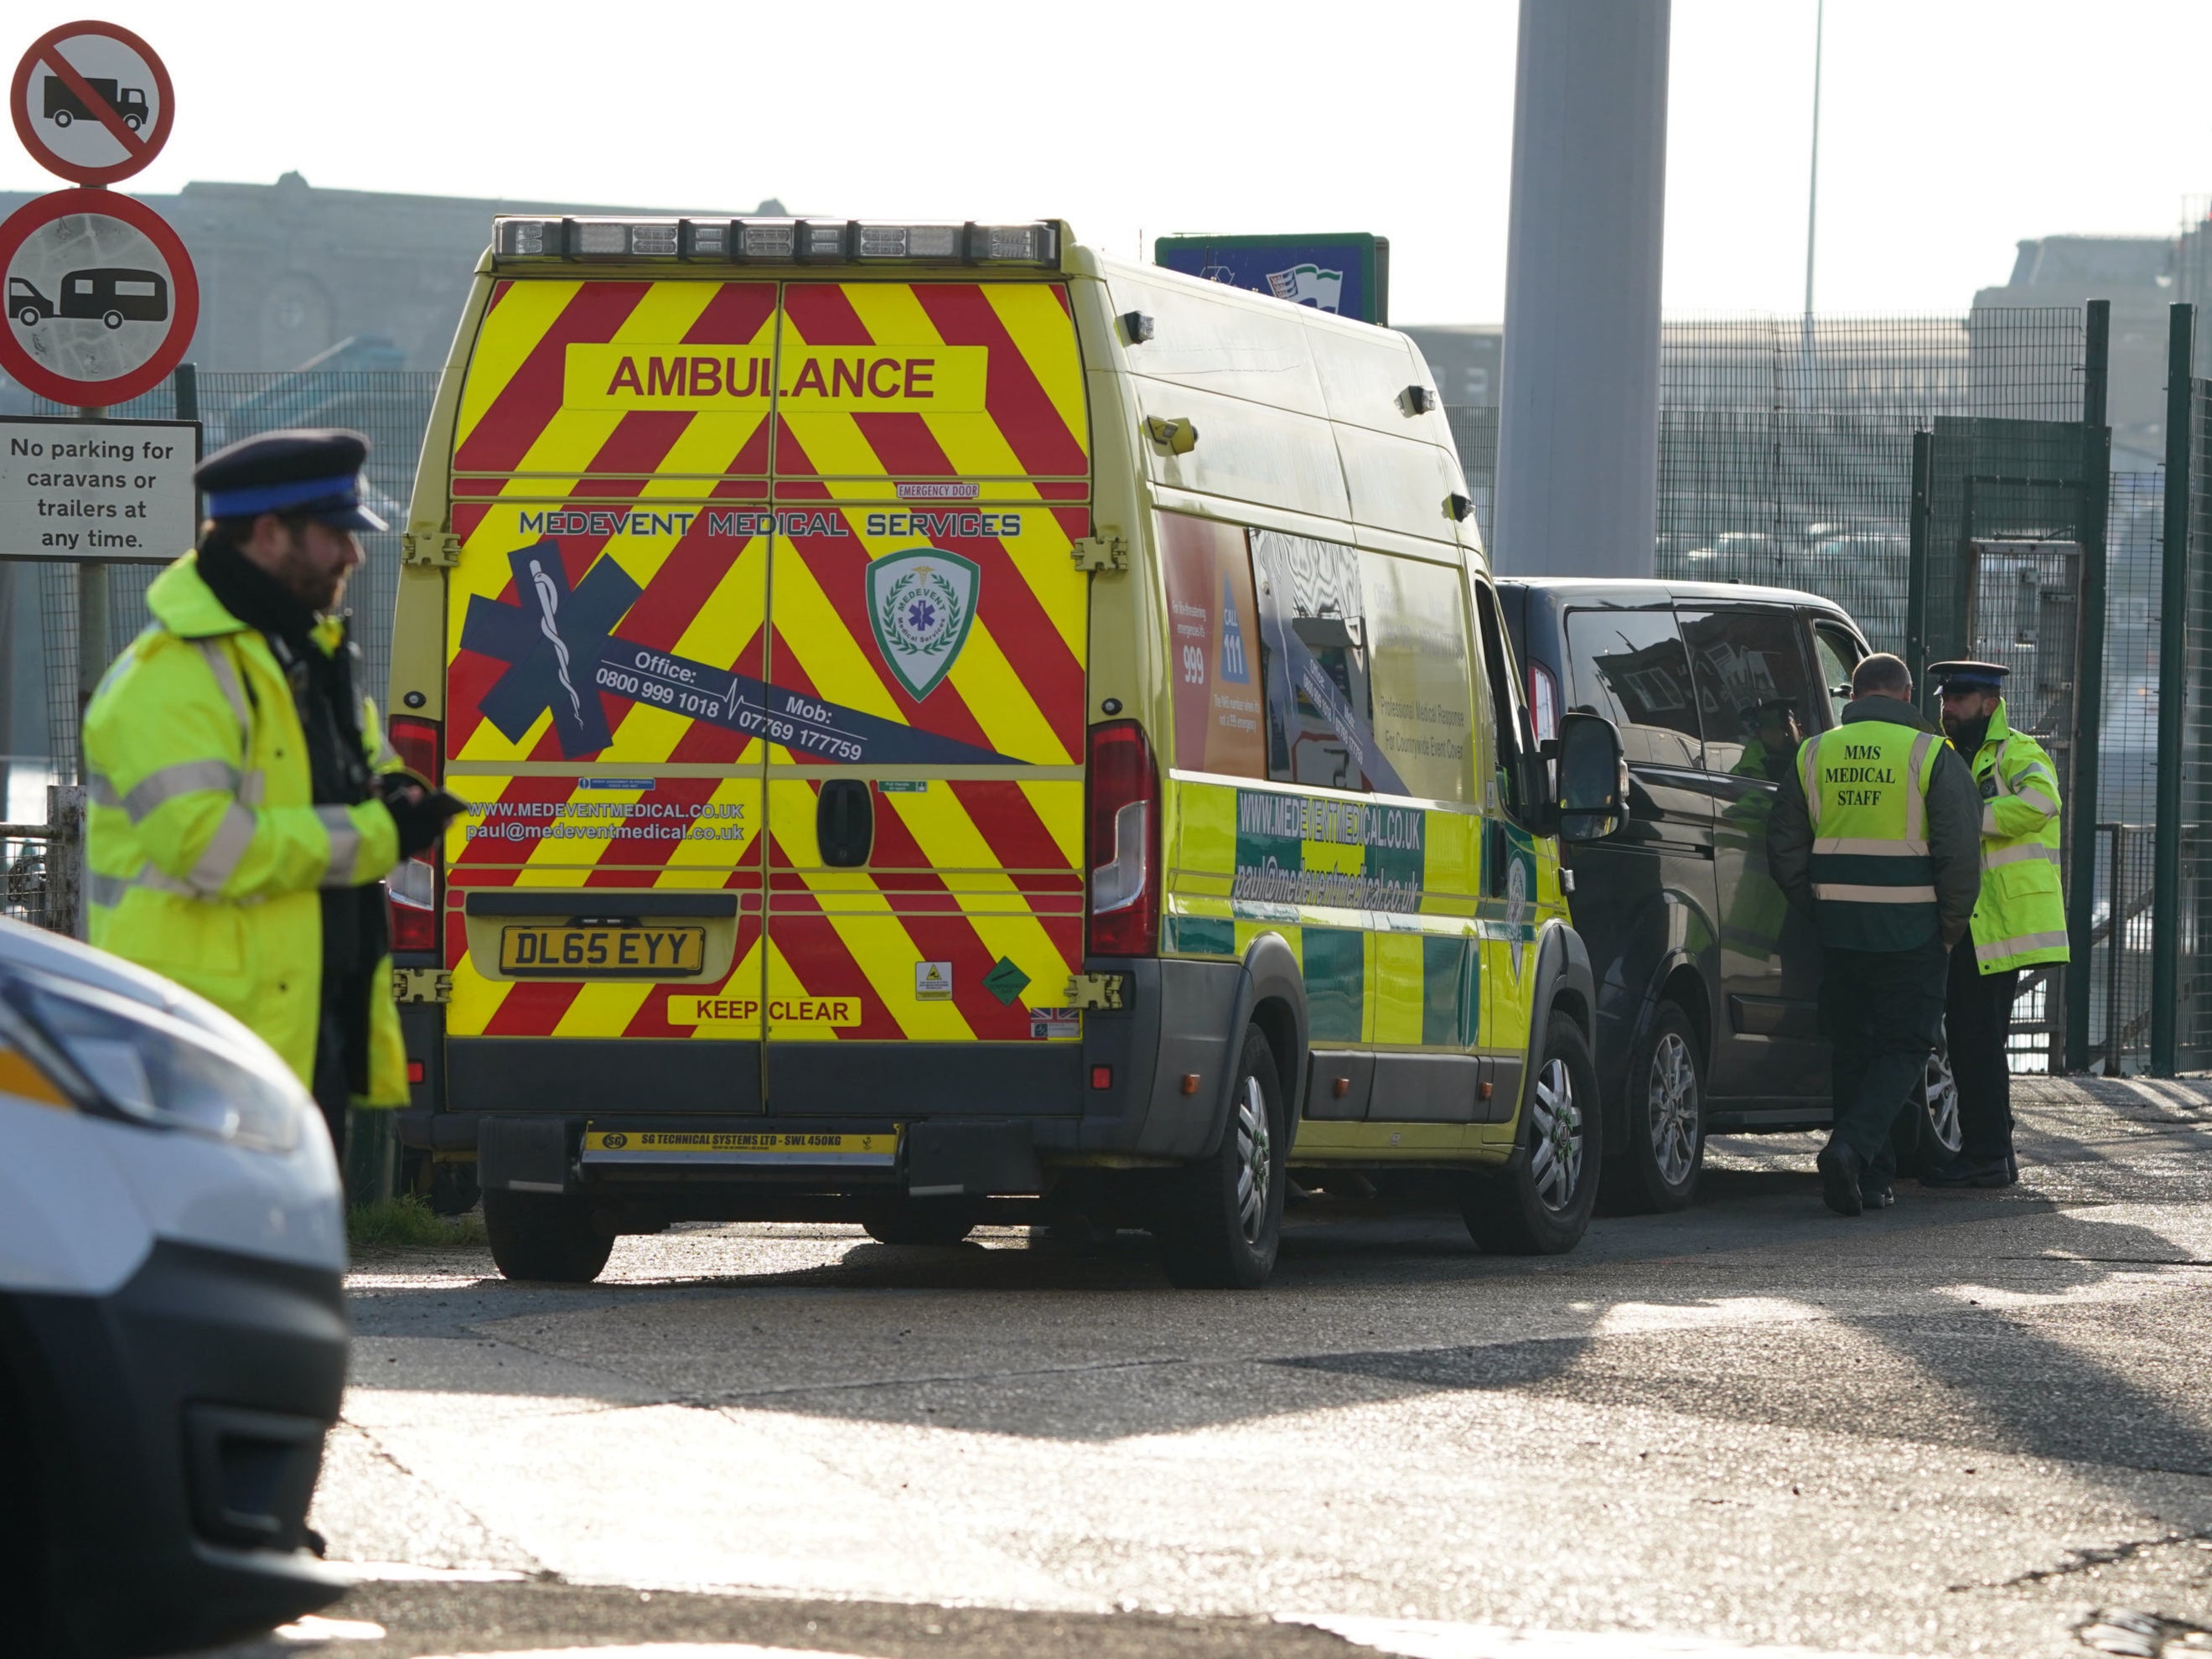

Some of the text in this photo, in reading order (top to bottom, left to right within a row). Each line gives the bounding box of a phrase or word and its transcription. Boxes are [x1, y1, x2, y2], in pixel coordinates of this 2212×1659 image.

[606, 356, 935, 398] AMBULANCE
[11, 438, 174, 462] No parking for
[27, 473, 157, 489] caravans or
[899, 485, 977, 496] EMERGENCY DOOR
[38, 499, 147, 518] trailers at
[518, 511, 1022, 537] MEDEVENT MEDICAL SERVICES
[42, 530, 142, 550] any time.
[898, 588, 946, 612] MEDEVENT
[898, 617, 946, 642] Medical Services
[1224, 609, 1238, 627] CALL
[1184, 645, 1204, 685] 999
[1224, 634, 1243, 675] 111
[635, 651, 697, 683] Office:
[596, 667, 719, 718] 0800 999 1018
[785, 696, 832, 724] Mob:
[1381, 696, 1464, 730] Professional Medical Response
[739, 711, 863, 761] 07769 177759
[1385, 730, 1463, 760] For Countrywide Event Cover
[1843, 744, 1882, 760] MMS
[1825, 767, 1896, 784] MEDICAL
[468, 802, 744, 819] WWW.MEDEVENTMEDICAL.CO.UK
[1837, 791, 1882, 806] STAFF
[466, 822, 744, 842] paul@medeventmedical.co.uk
[1240, 793, 1421, 851] WWW.MEDEVENTMEDICAL.CO.UK
[1234, 855, 1419, 914] paul@medeventmedical.co.uk
[515, 933, 688, 965] DL65 EYY
[697, 1000, 850, 1022] KEEP CLEAR
[605, 1135, 624, 1147] SG
[641, 1133, 656, 1145] SG
[657, 1134, 711, 1145] TECHNICAL
[712, 1134, 759, 1146] SYSTEMS
[759, 1135, 776, 1146] LTD
[784, 1135, 806, 1146] SWL
[807, 1135, 842, 1147] 450KG
